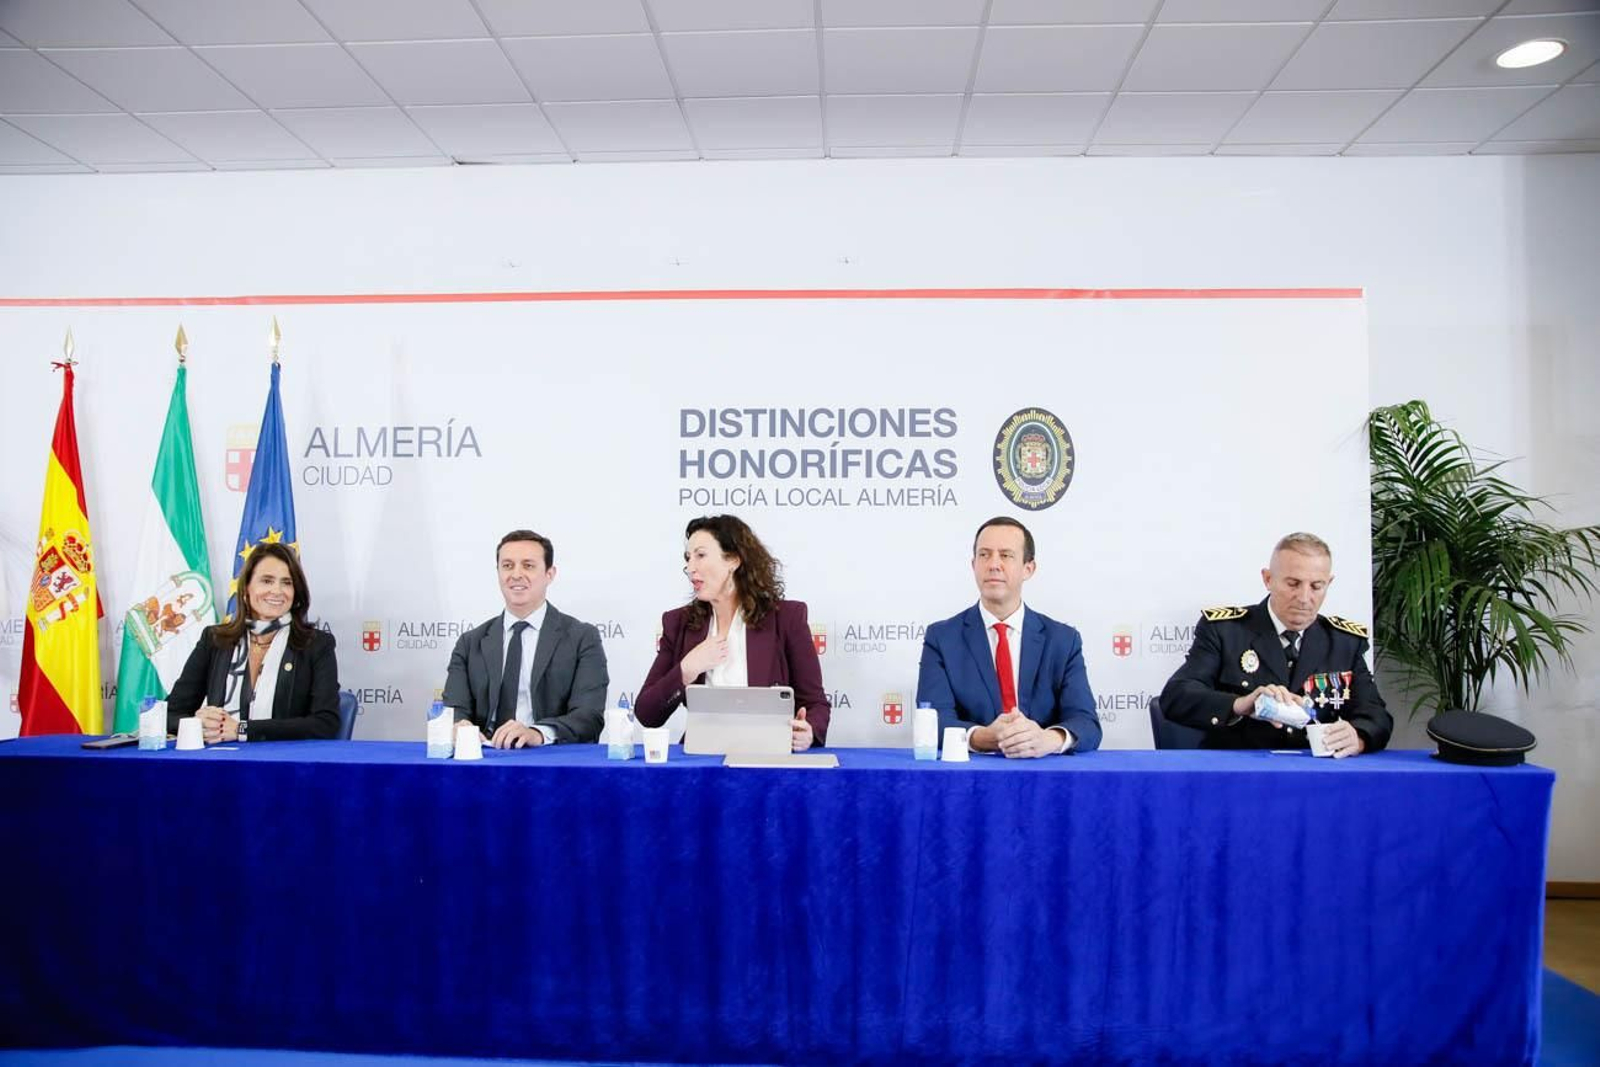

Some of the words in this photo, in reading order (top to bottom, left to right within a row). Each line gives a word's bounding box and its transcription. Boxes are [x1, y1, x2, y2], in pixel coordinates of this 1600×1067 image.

[680, 407, 958, 438] DISTINCIONES
[304, 418, 482, 458] ALMERÍA
[680, 441, 958, 479] HONORÍFICAS
[303, 465, 393, 486] CIUDAD
[679, 484, 768, 507] POLICÍA
[775, 487, 850, 507] LOCAL
[857, 484, 958, 507] ALMERÍA
[397, 640, 437, 649] CIUDAD
[844, 643, 887, 652] CIUDAD
